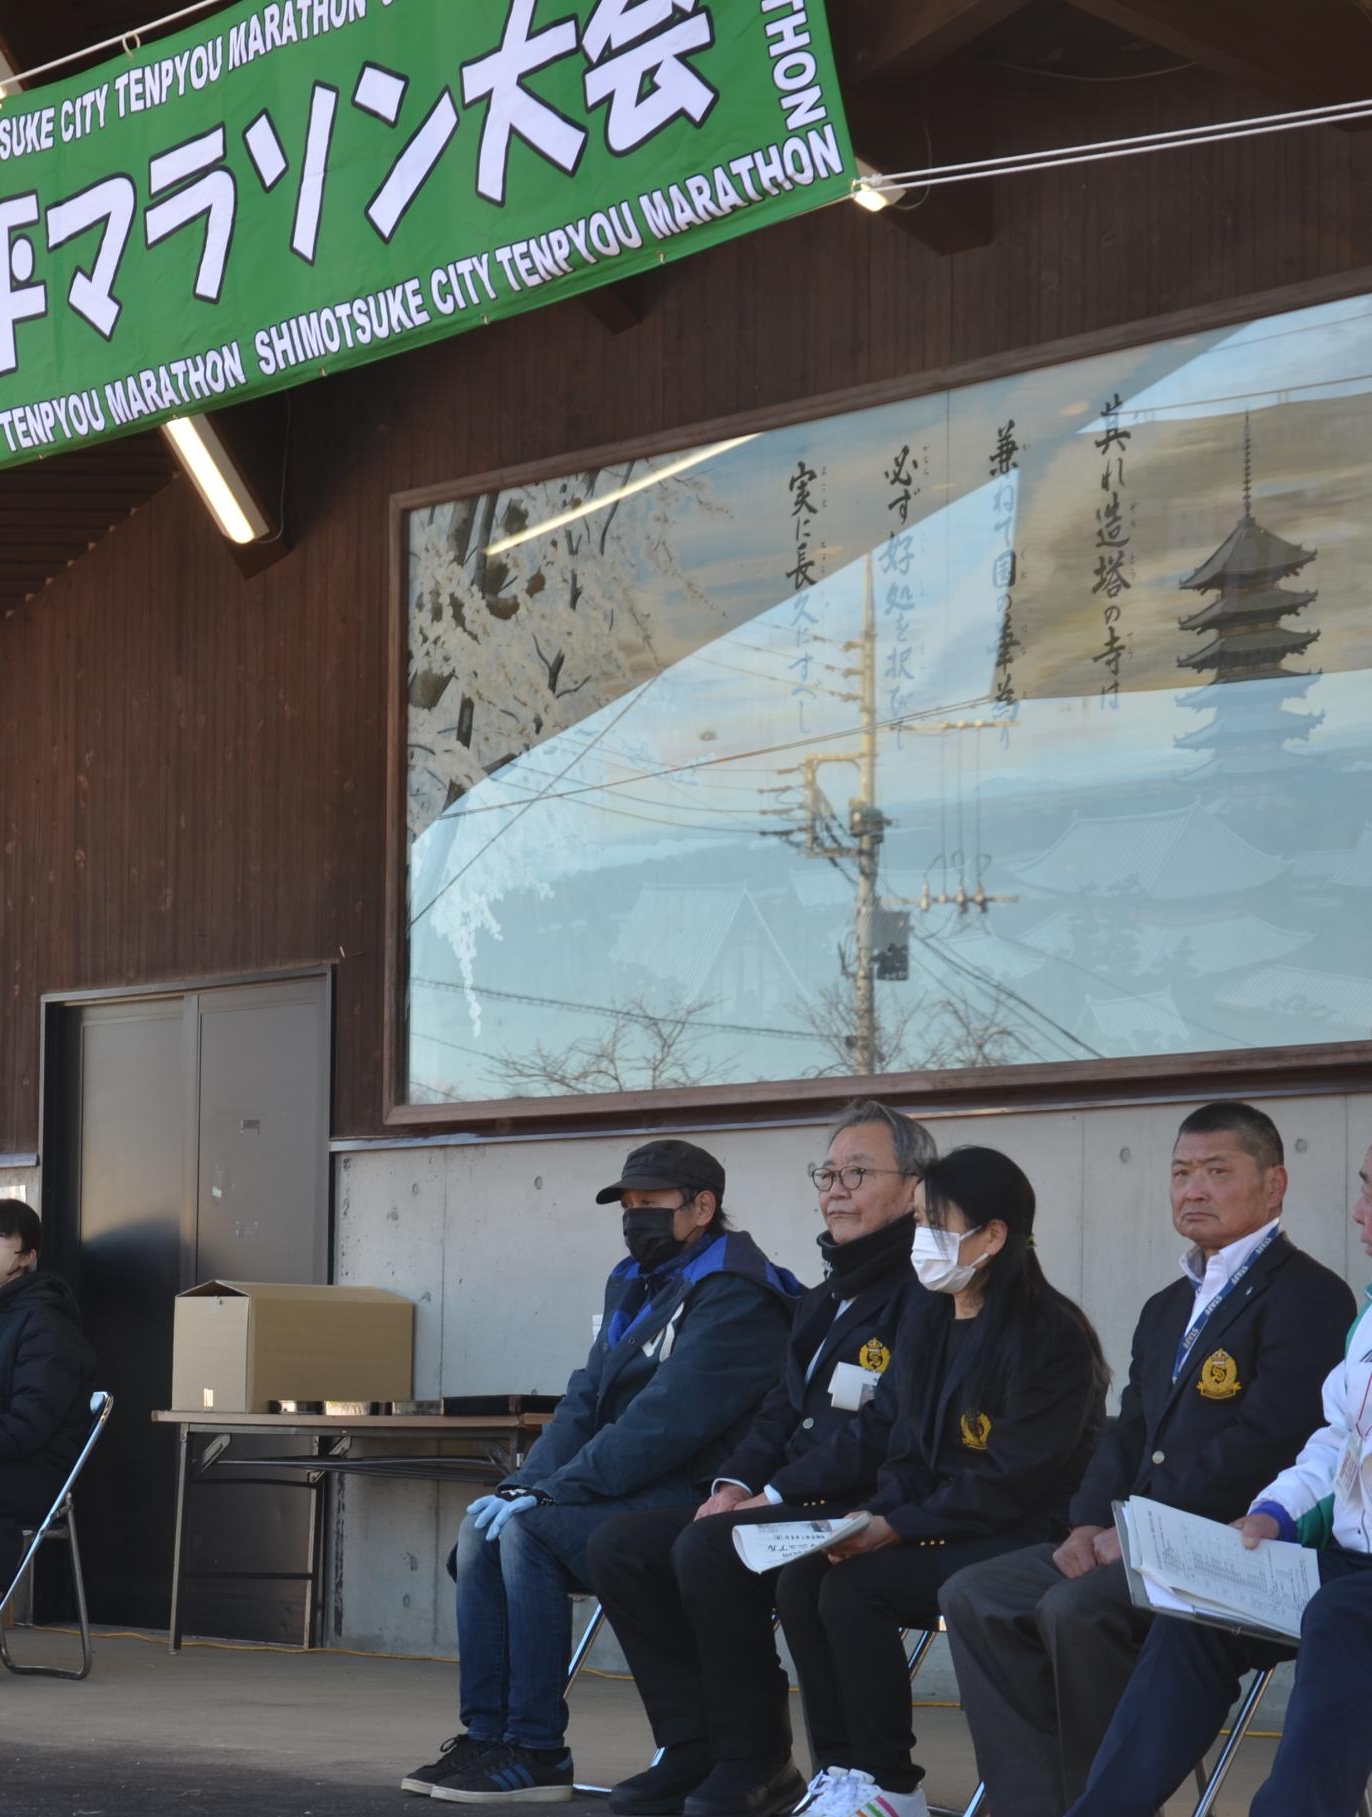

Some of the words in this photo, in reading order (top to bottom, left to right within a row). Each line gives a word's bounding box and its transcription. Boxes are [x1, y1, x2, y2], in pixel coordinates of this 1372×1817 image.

[60, 84, 109, 143] CITY
[114, 37, 224, 118] TENPYOU
[103, 340, 248, 427] MARATHON
[253, 277, 432, 376] SHIMOTSUKE
[429, 252, 497, 316] CITY
[494, 200, 644, 293] TENPYOU
[636, 123, 844, 241] MARATHON
[1255, 1236, 1273, 1255] STAFF
[1230, 1264, 1250, 1286] STAFF
[1204, 1294, 1224, 1316] STAFF
[1182, 1327, 1200, 1350] STAFF
